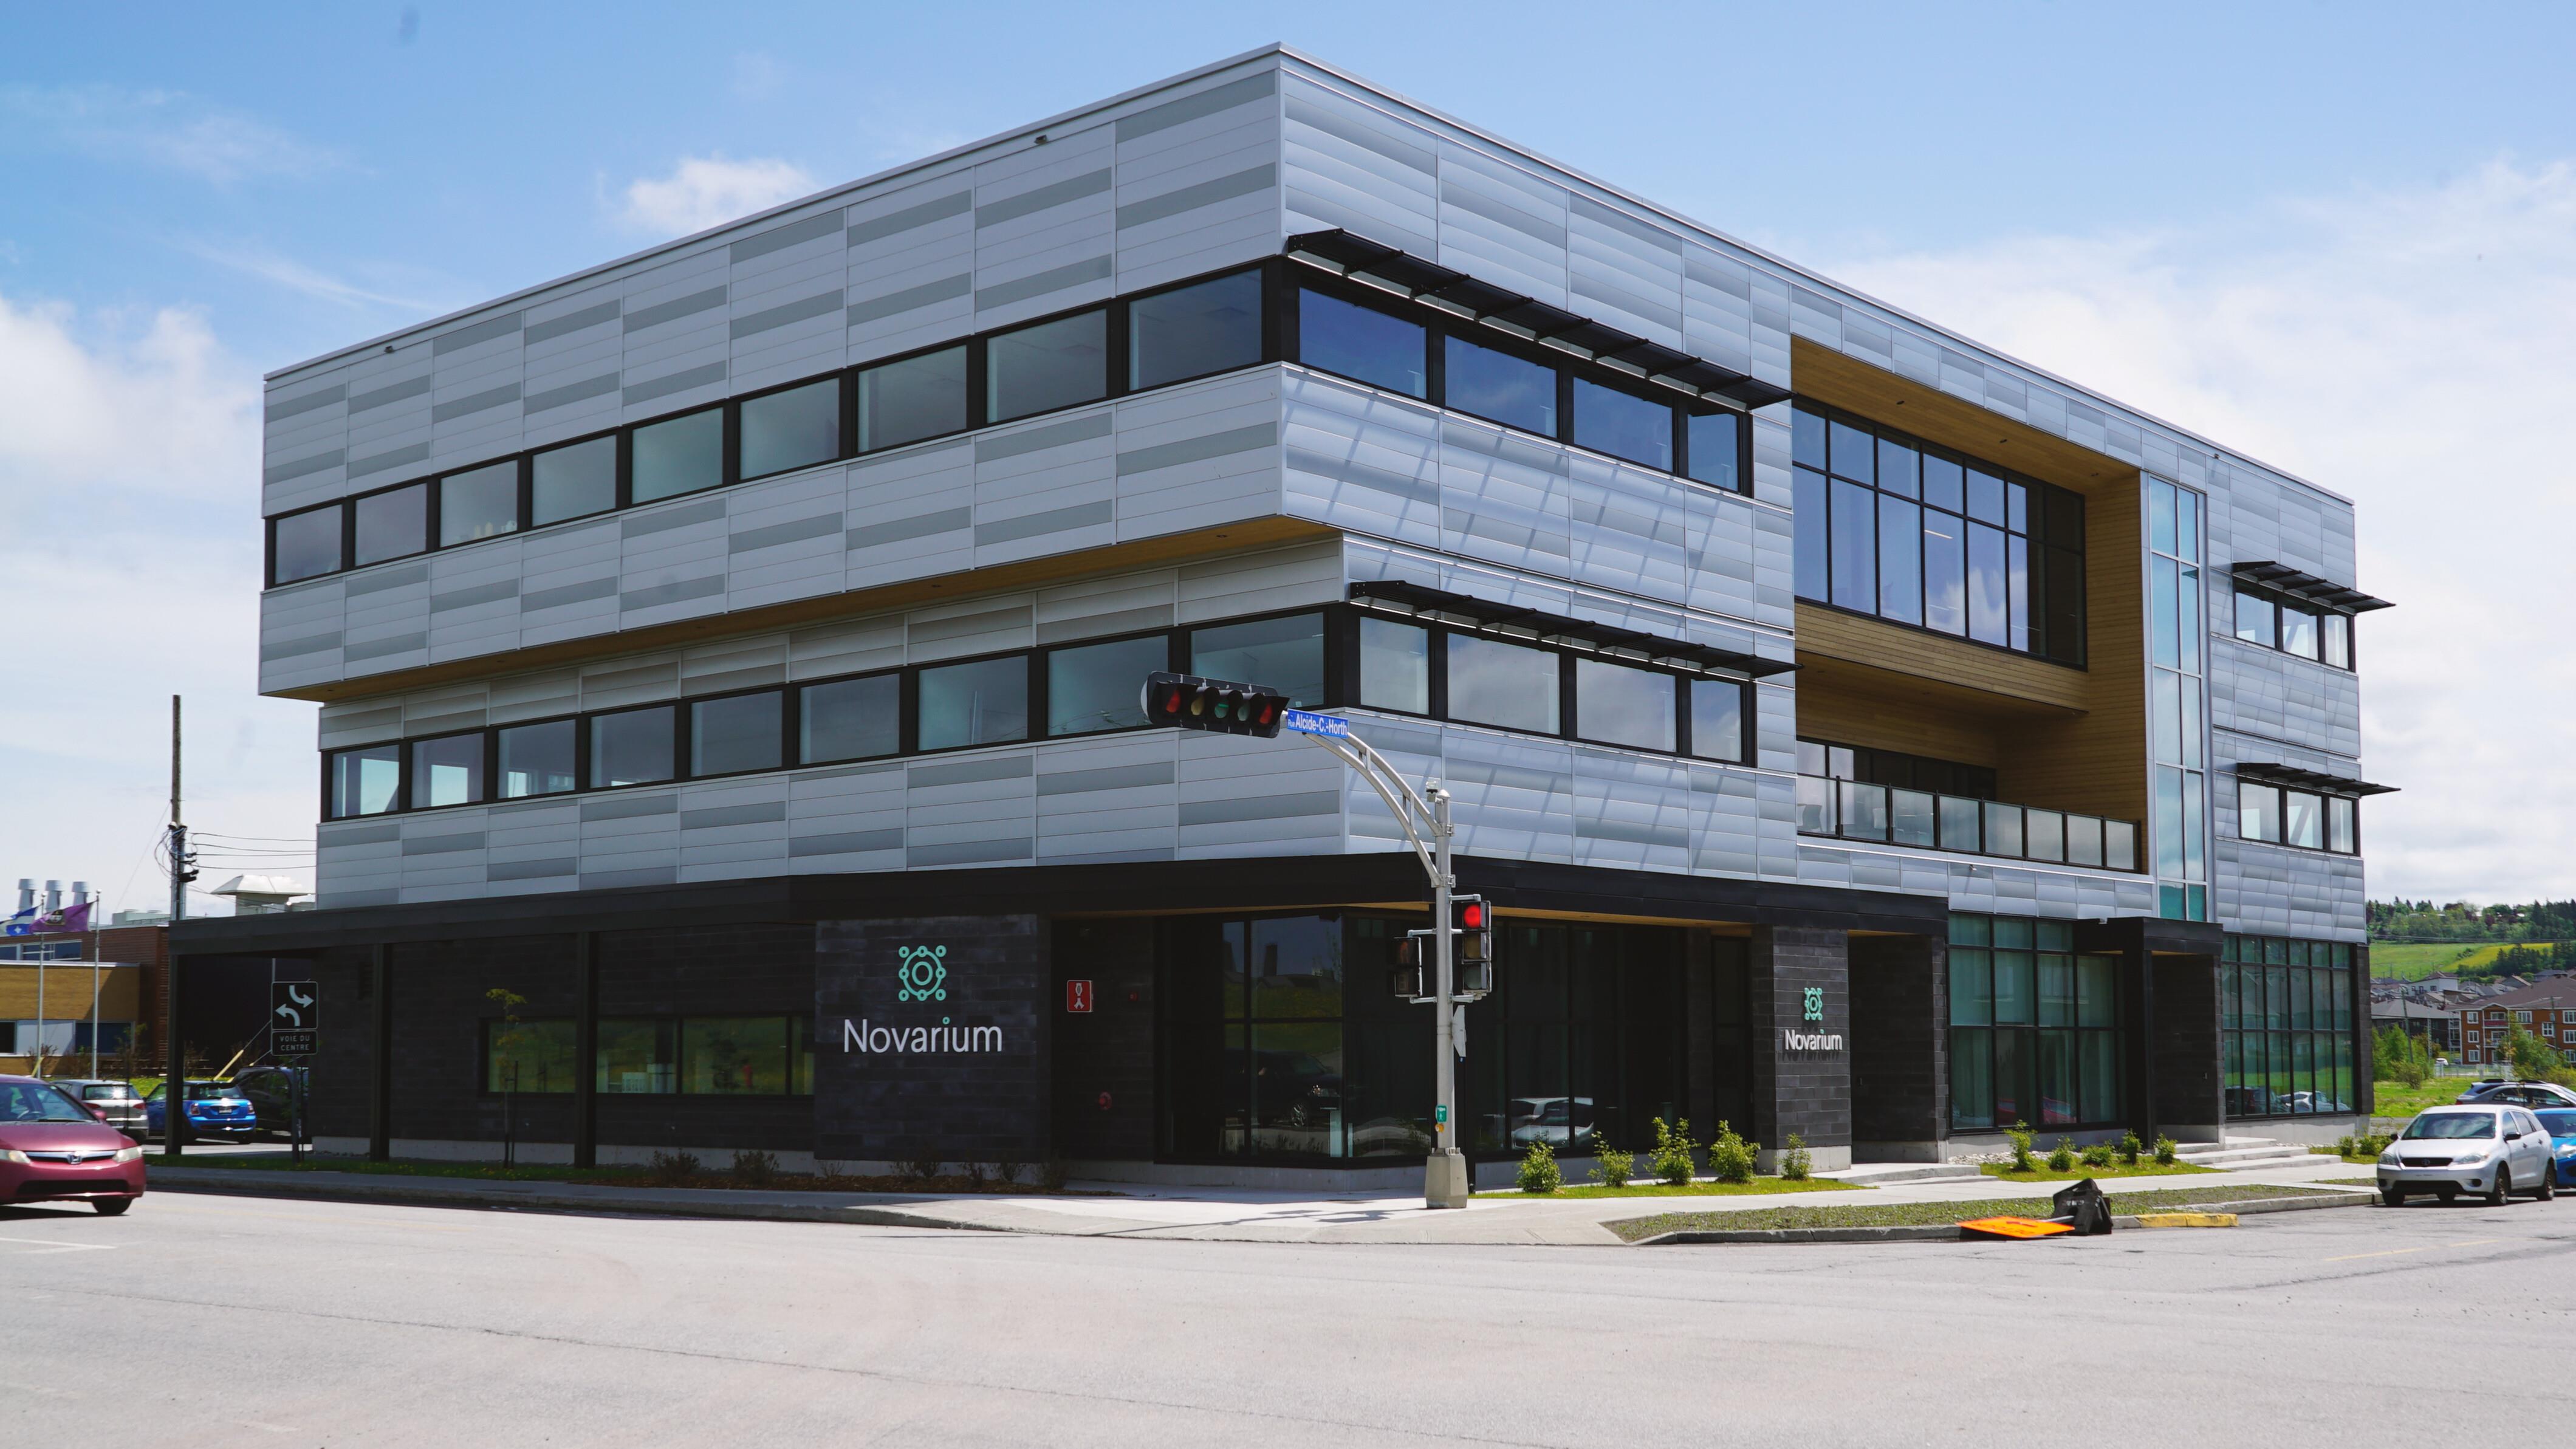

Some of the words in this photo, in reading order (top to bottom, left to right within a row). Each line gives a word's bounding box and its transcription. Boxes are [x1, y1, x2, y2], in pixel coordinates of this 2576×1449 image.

[1295, 713, 1348, 736] Alcide-C.-Horth
[844, 1016, 1002, 1053] Novarium
[1785, 1029, 1843, 1050] Novarium
